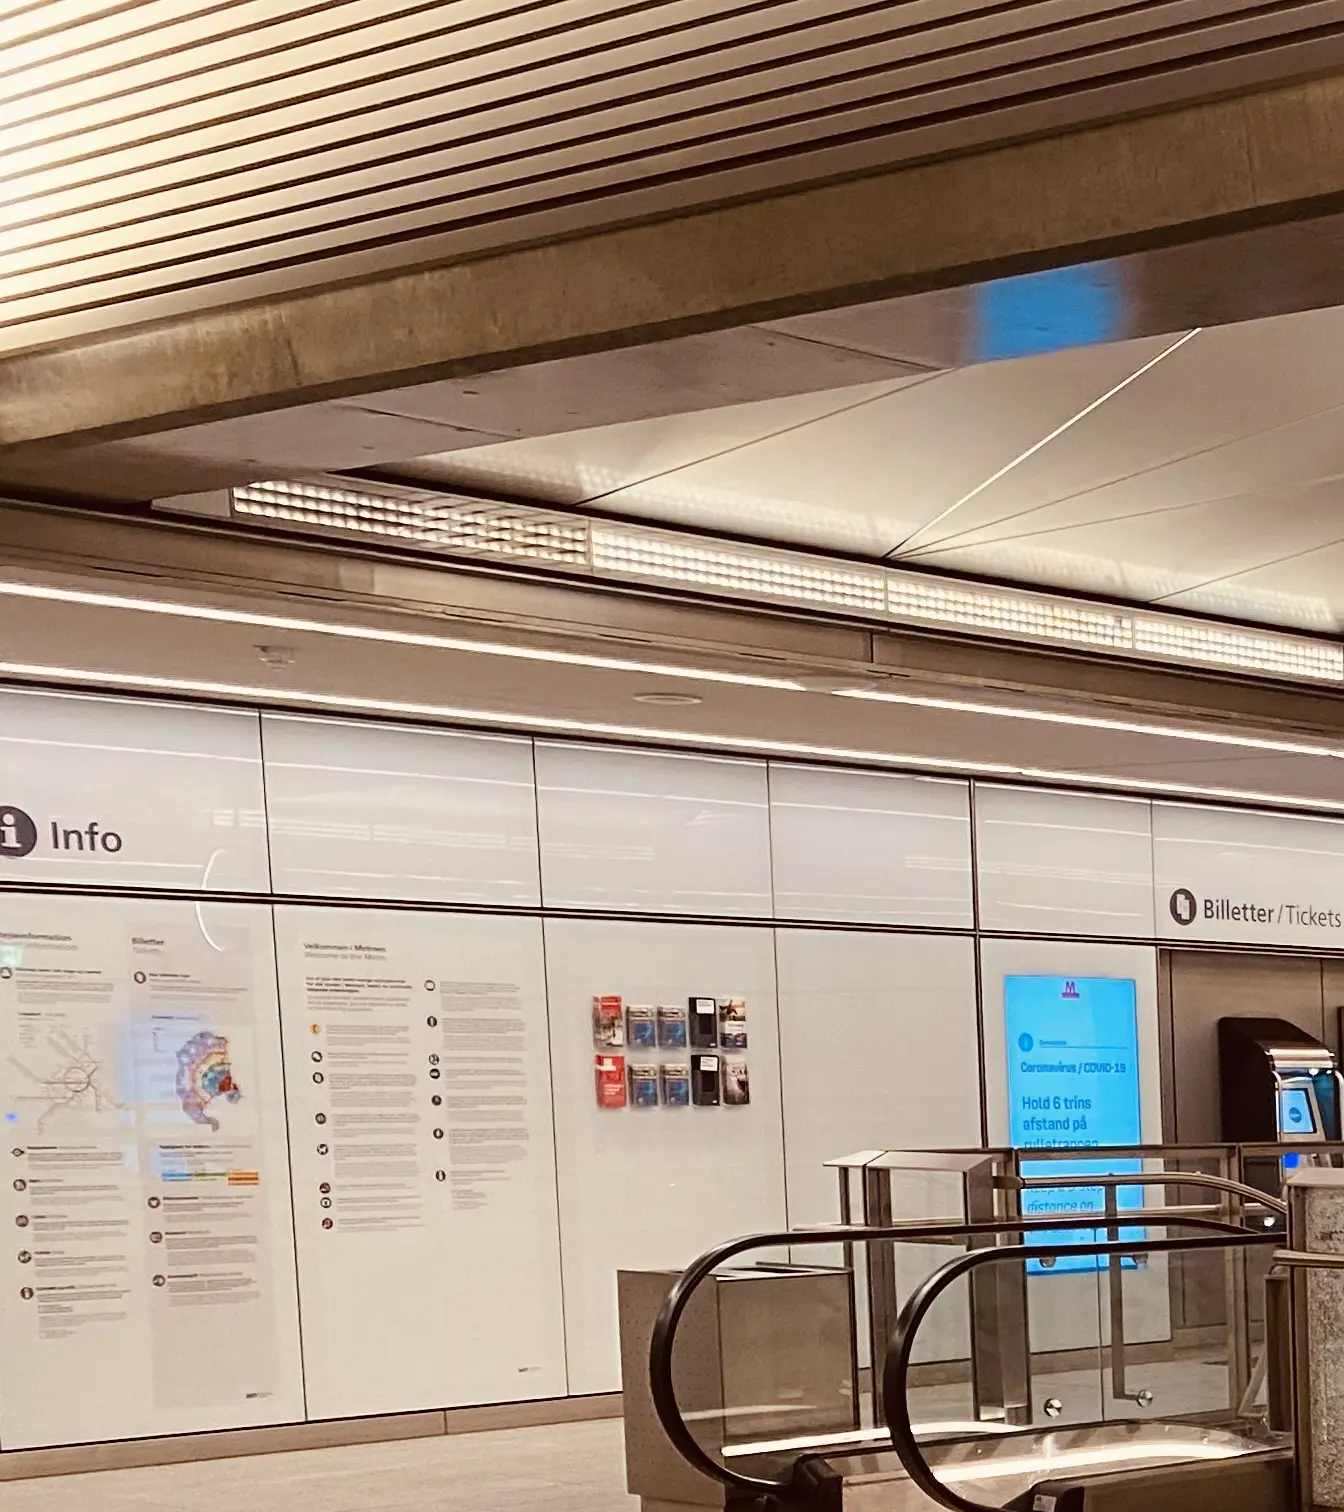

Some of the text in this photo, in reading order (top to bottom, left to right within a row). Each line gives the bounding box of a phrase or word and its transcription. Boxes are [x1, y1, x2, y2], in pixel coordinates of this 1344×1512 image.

[51, 821, 122, 853] Info
[1204, 899, 1274, 923] Billetter
[1286, 905, 1341, 928] Tickets
[1020, 1061, 1077, 1073] Coronavirus
[1084, 1062, 1126, 1073] COVID-19
[1022, 1095, 1091, 1110] Hold 6 trins
[1023, 1115, 1087, 1133] afstand på
[1027, 1200, 1077, 1214] distance
